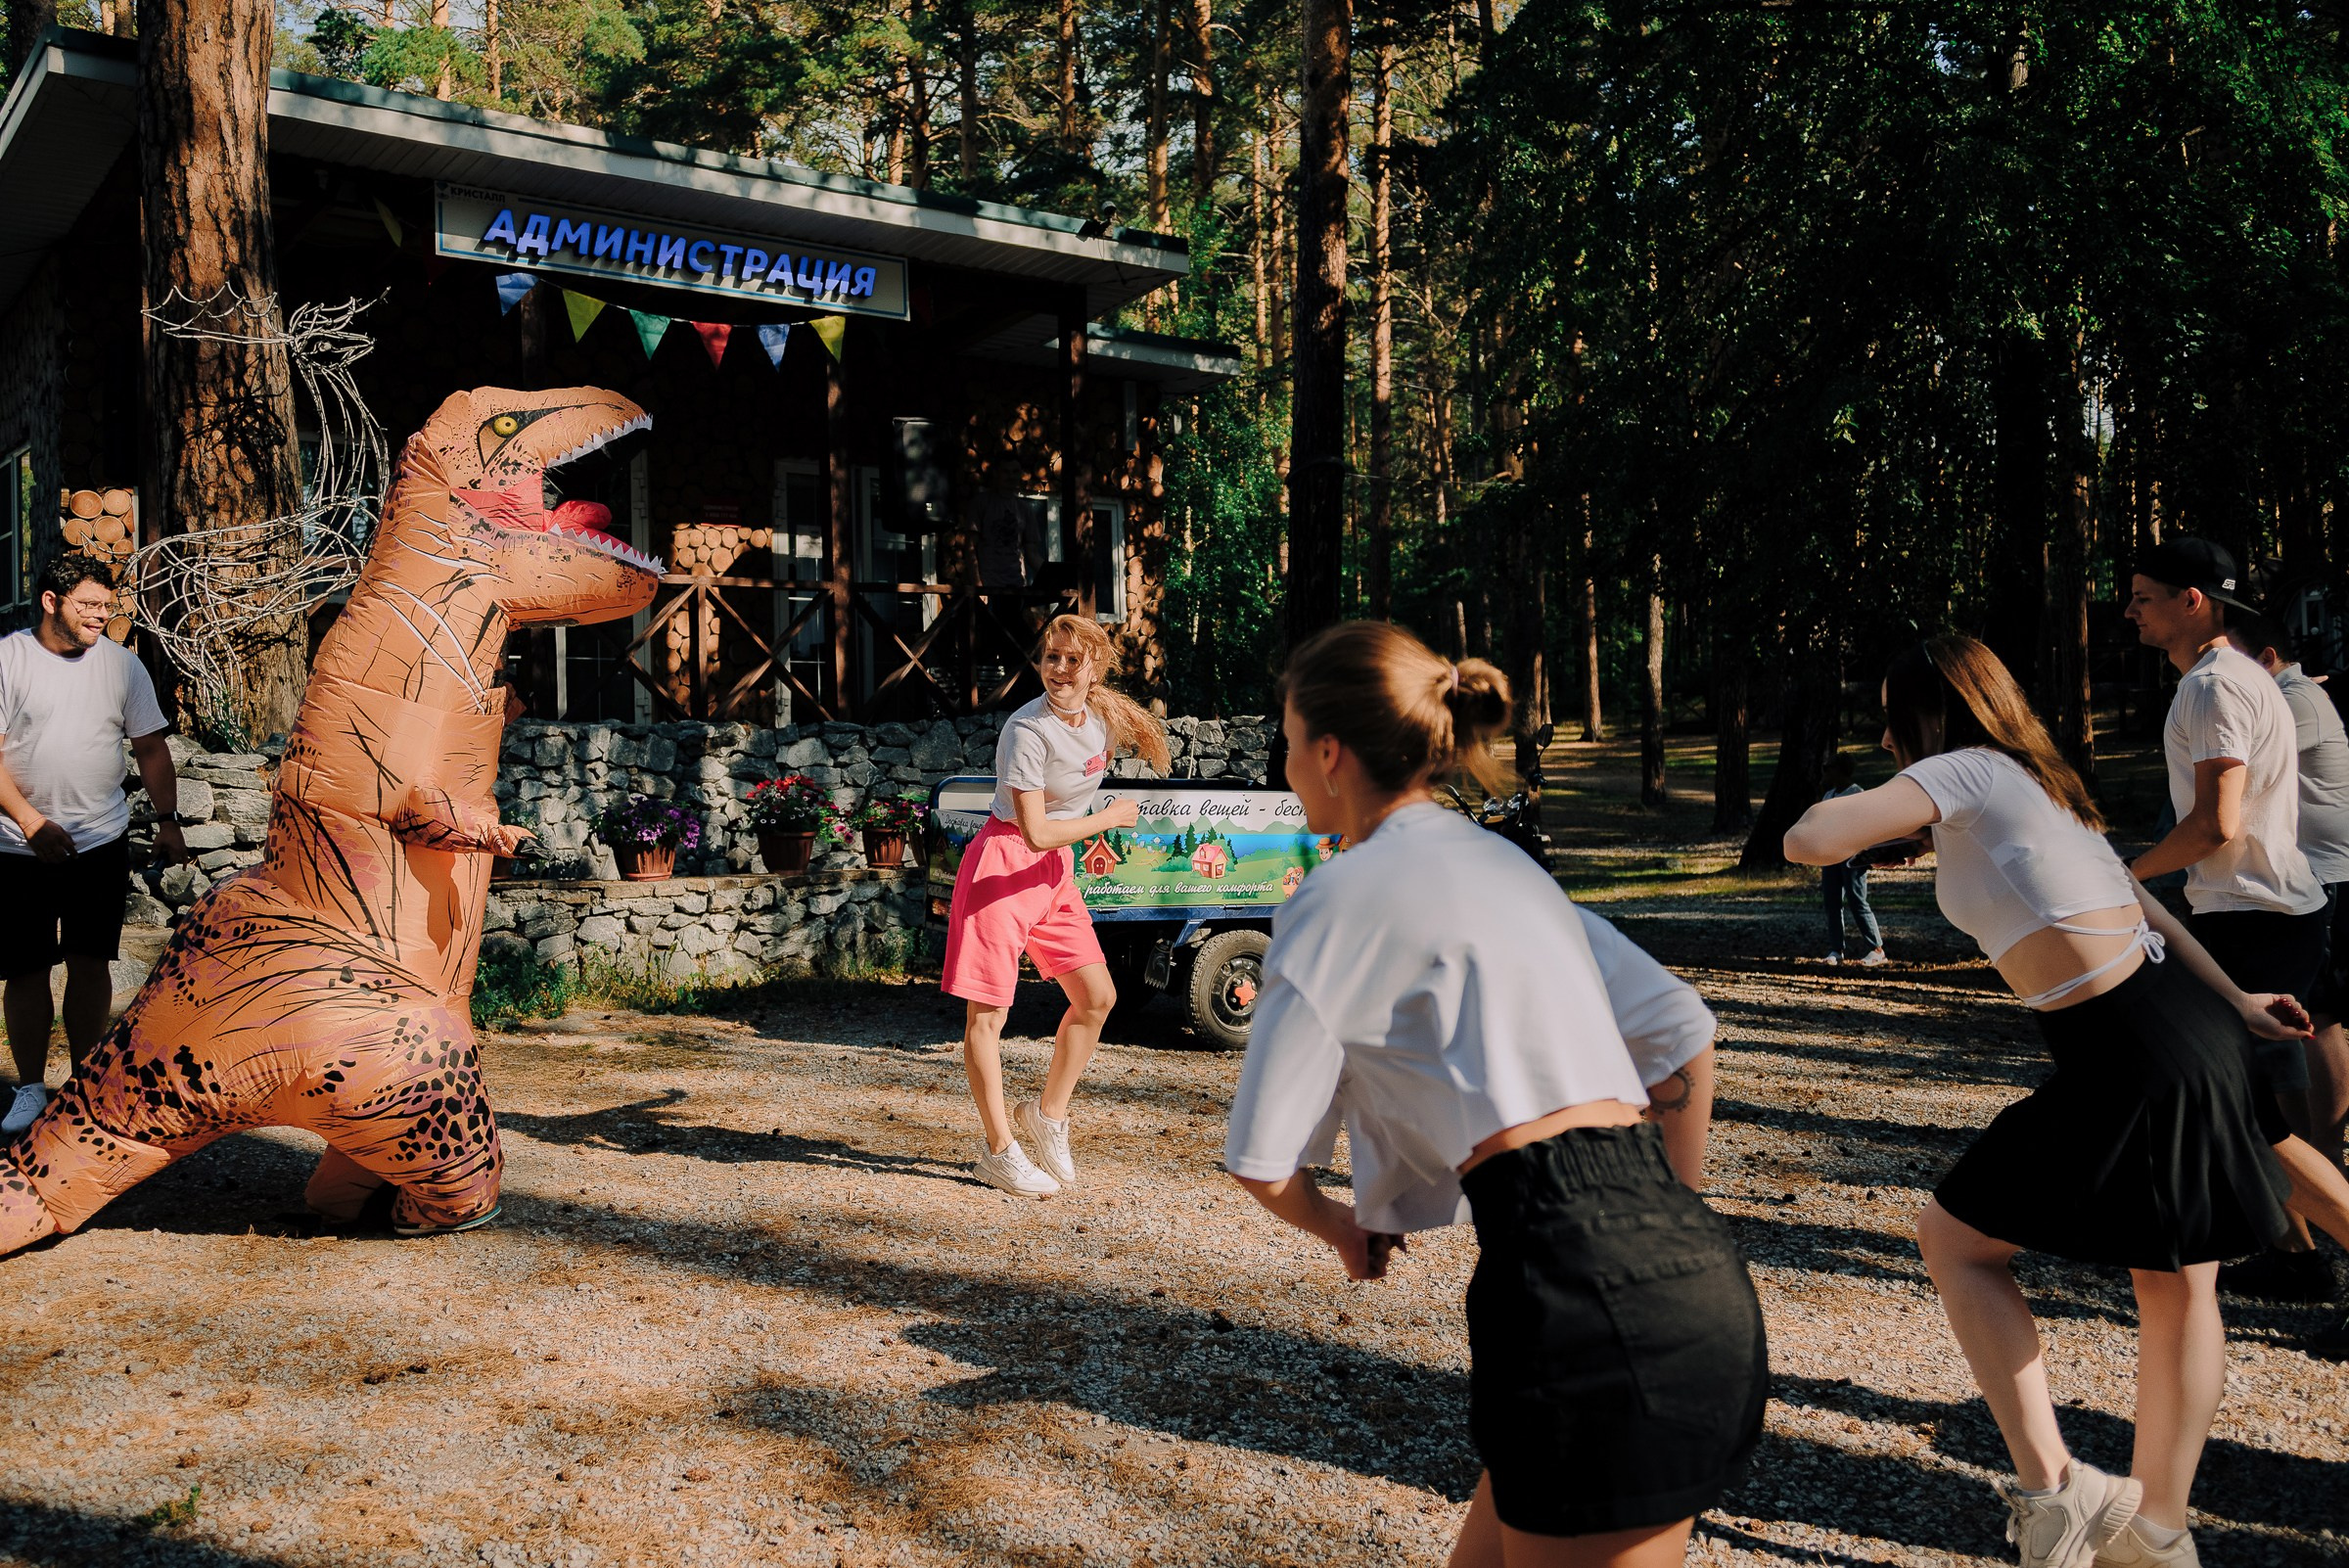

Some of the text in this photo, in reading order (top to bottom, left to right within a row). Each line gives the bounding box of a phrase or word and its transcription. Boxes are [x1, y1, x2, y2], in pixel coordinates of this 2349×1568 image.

[484, 208, 877, 298] АДМИНИСТРАЦИЯ
[1199, 799, 1252, 819] вещей
[1083, 882, 1144, 899] работаем
[1148, 884, 1171, 898] для
[1174, 881, 1213, 894] вашего
[1216, 881, 1274, 897] комфорта
